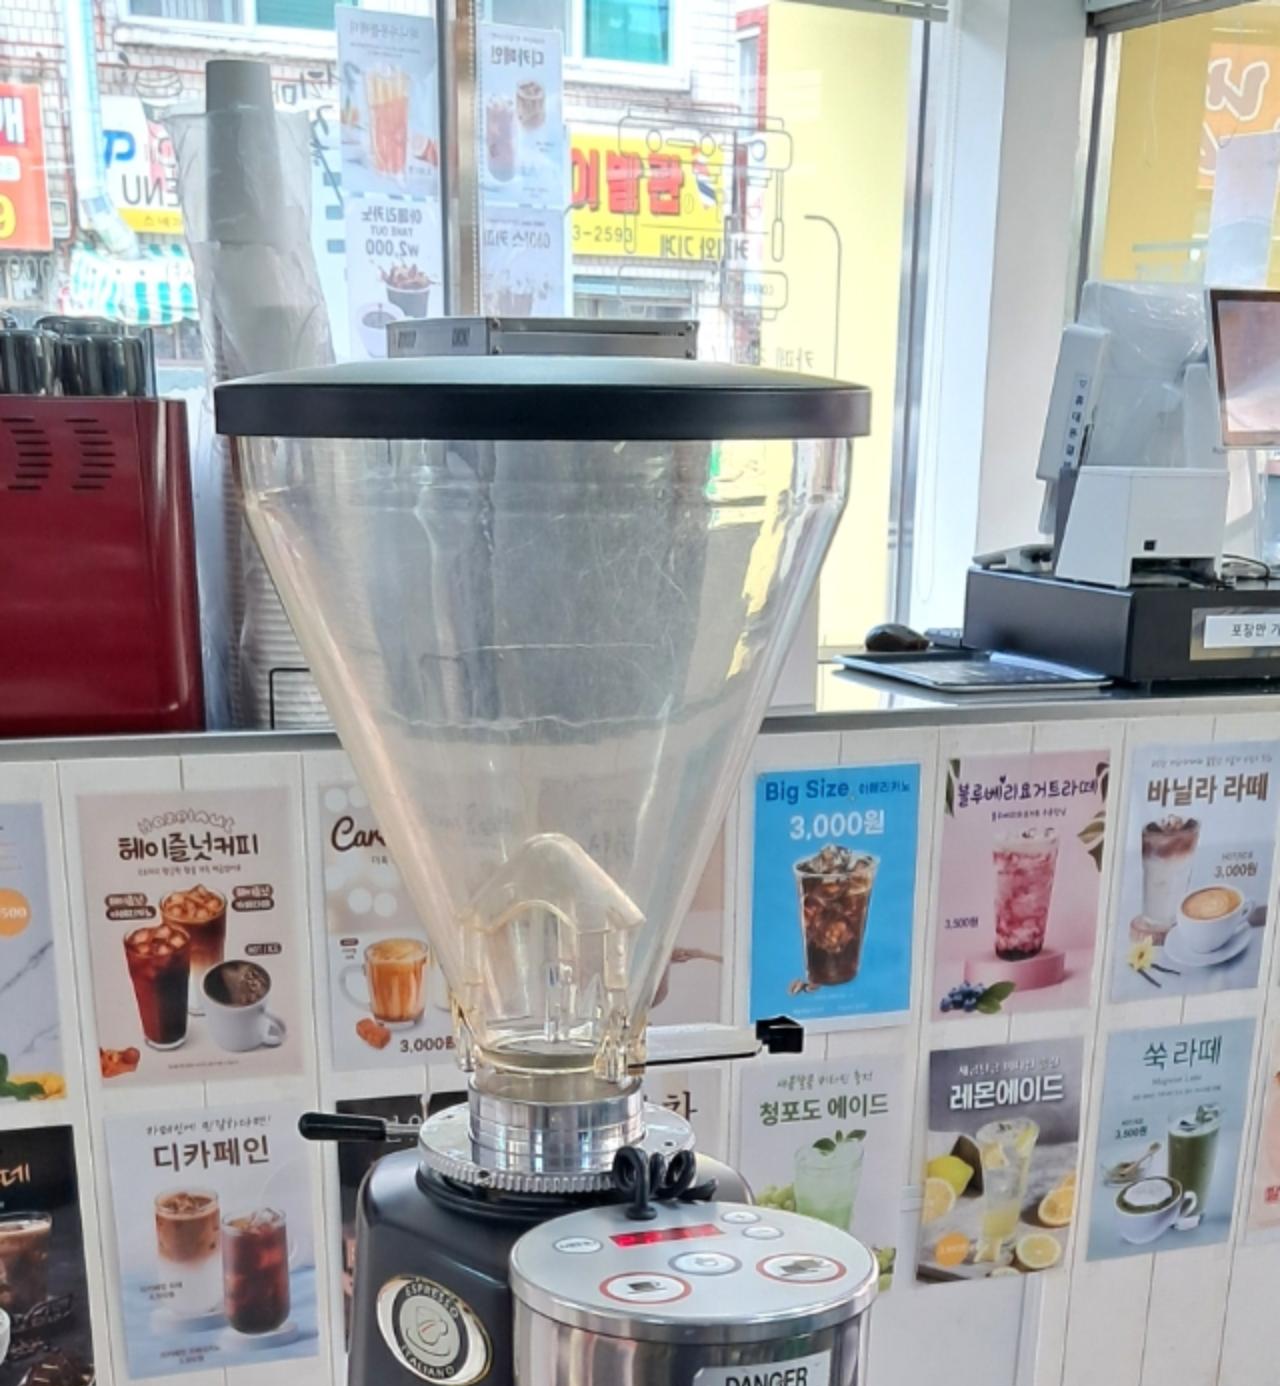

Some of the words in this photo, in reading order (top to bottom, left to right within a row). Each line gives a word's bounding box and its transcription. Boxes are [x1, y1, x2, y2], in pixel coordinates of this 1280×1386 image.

[1231, 623, 1267, 639] 포장만
[765, 781, 799, 804] Big
[806, 778, 850, 798] Size
[957, 779, 1099, 808] 블루베리요거트라떼
[1148, 775, 1218, 807] 바닐라
[1223, 772, 1269, 803] 라떼
[790, 810, 885, 840] 3,000원
[117, 831, 259, 863] 헤이즐넛커피
[1143, 1041, 1168, 1071] 쑥
[1173, 1035, 1223, 1068] 라떼
[949, 1074, 1064, 1111] 레몬에이드
[759, 1099, 822, 1126] 청포도
[827, 1094, 889, 1120] 에이드
[153, 1134, 270, 1172] 디카페인
[405, 1282, 459, 1319] ESPRESSO
[401, 1344, 455, 1378] ITALIANO
